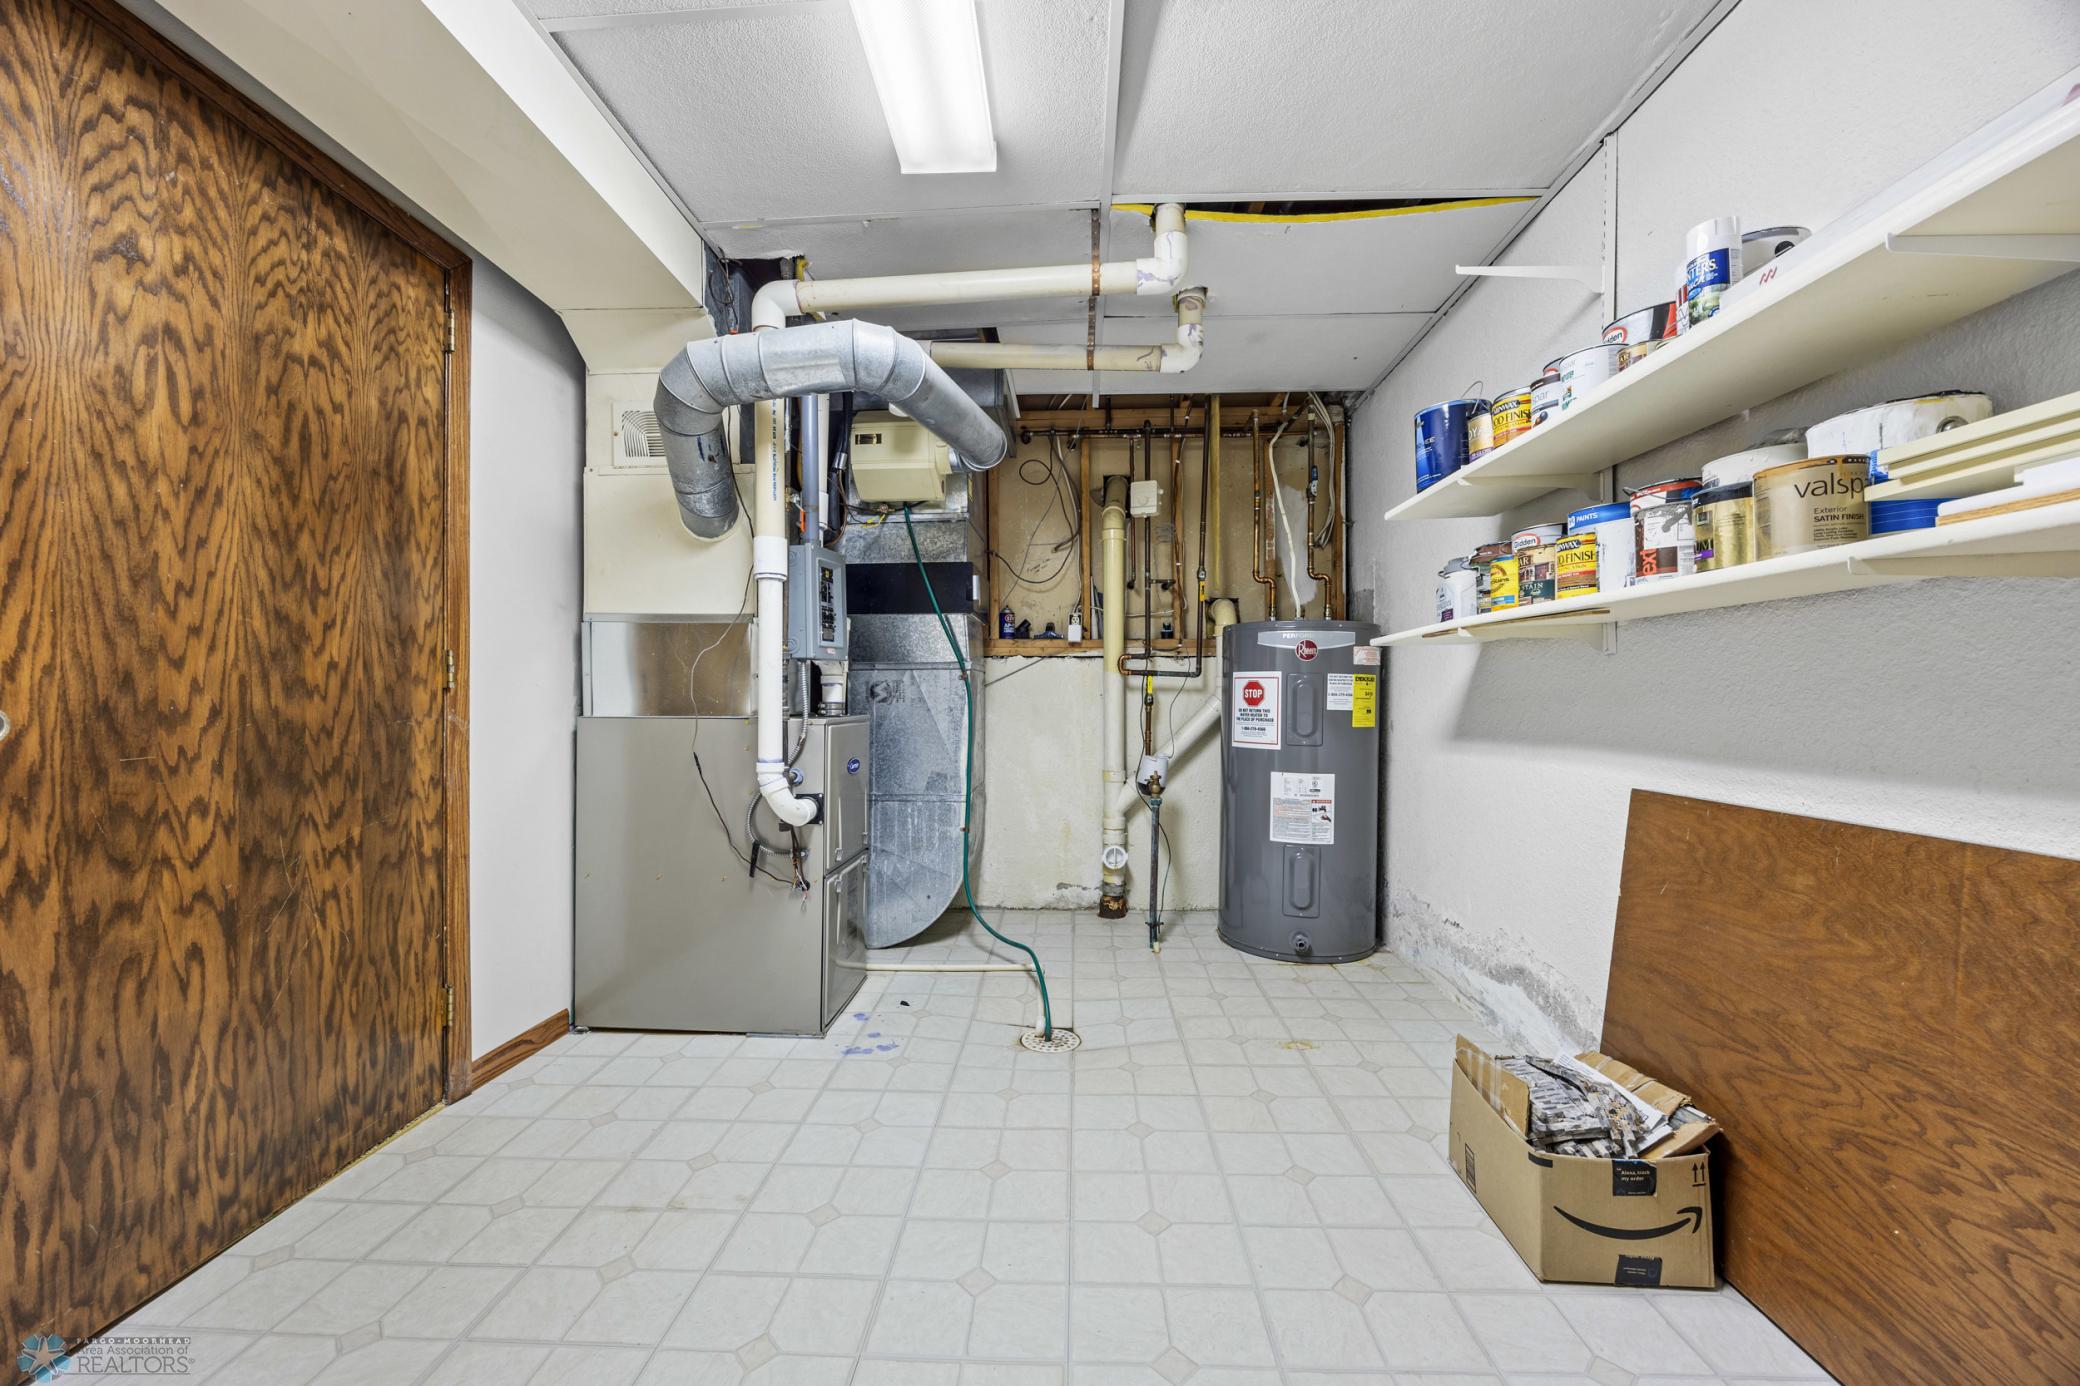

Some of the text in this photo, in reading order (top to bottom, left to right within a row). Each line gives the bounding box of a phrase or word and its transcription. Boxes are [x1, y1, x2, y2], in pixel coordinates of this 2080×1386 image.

[1814, 507, 1847, 515] Exterior
[1576, 512, 1598, 523] PAINTS
[1814, 513, 1865, 523] SATIN FINISH
[1244, 688, 1263, 698] STOP
